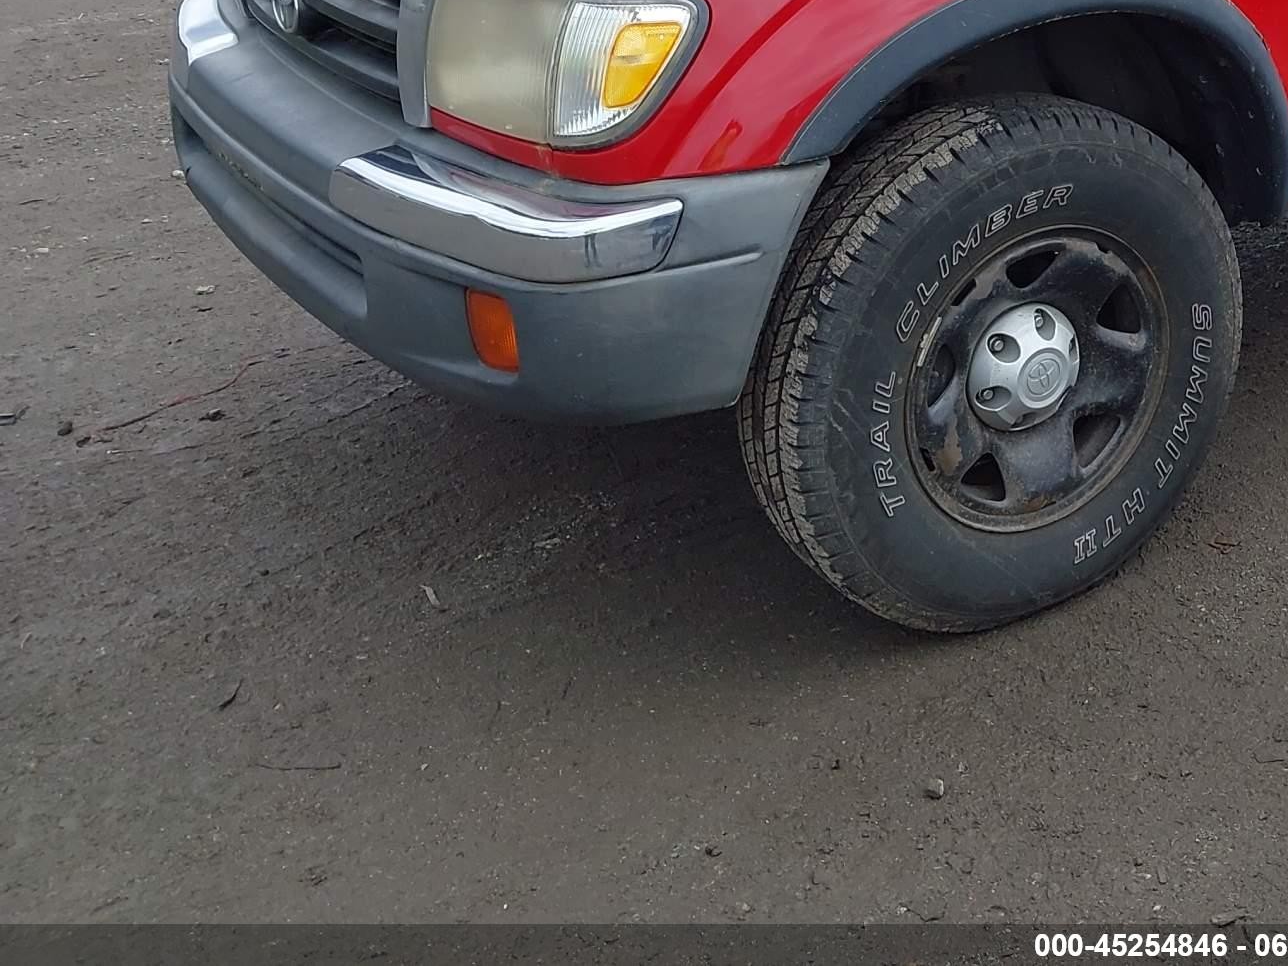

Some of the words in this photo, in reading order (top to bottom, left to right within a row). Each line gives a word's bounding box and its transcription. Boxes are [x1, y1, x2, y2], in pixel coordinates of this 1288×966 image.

[869, 369, 906, 518] TRAIL
[895, 183, 1075, 343] CLIMBER
[1154, 302, 1213, 490] SUMMIT
